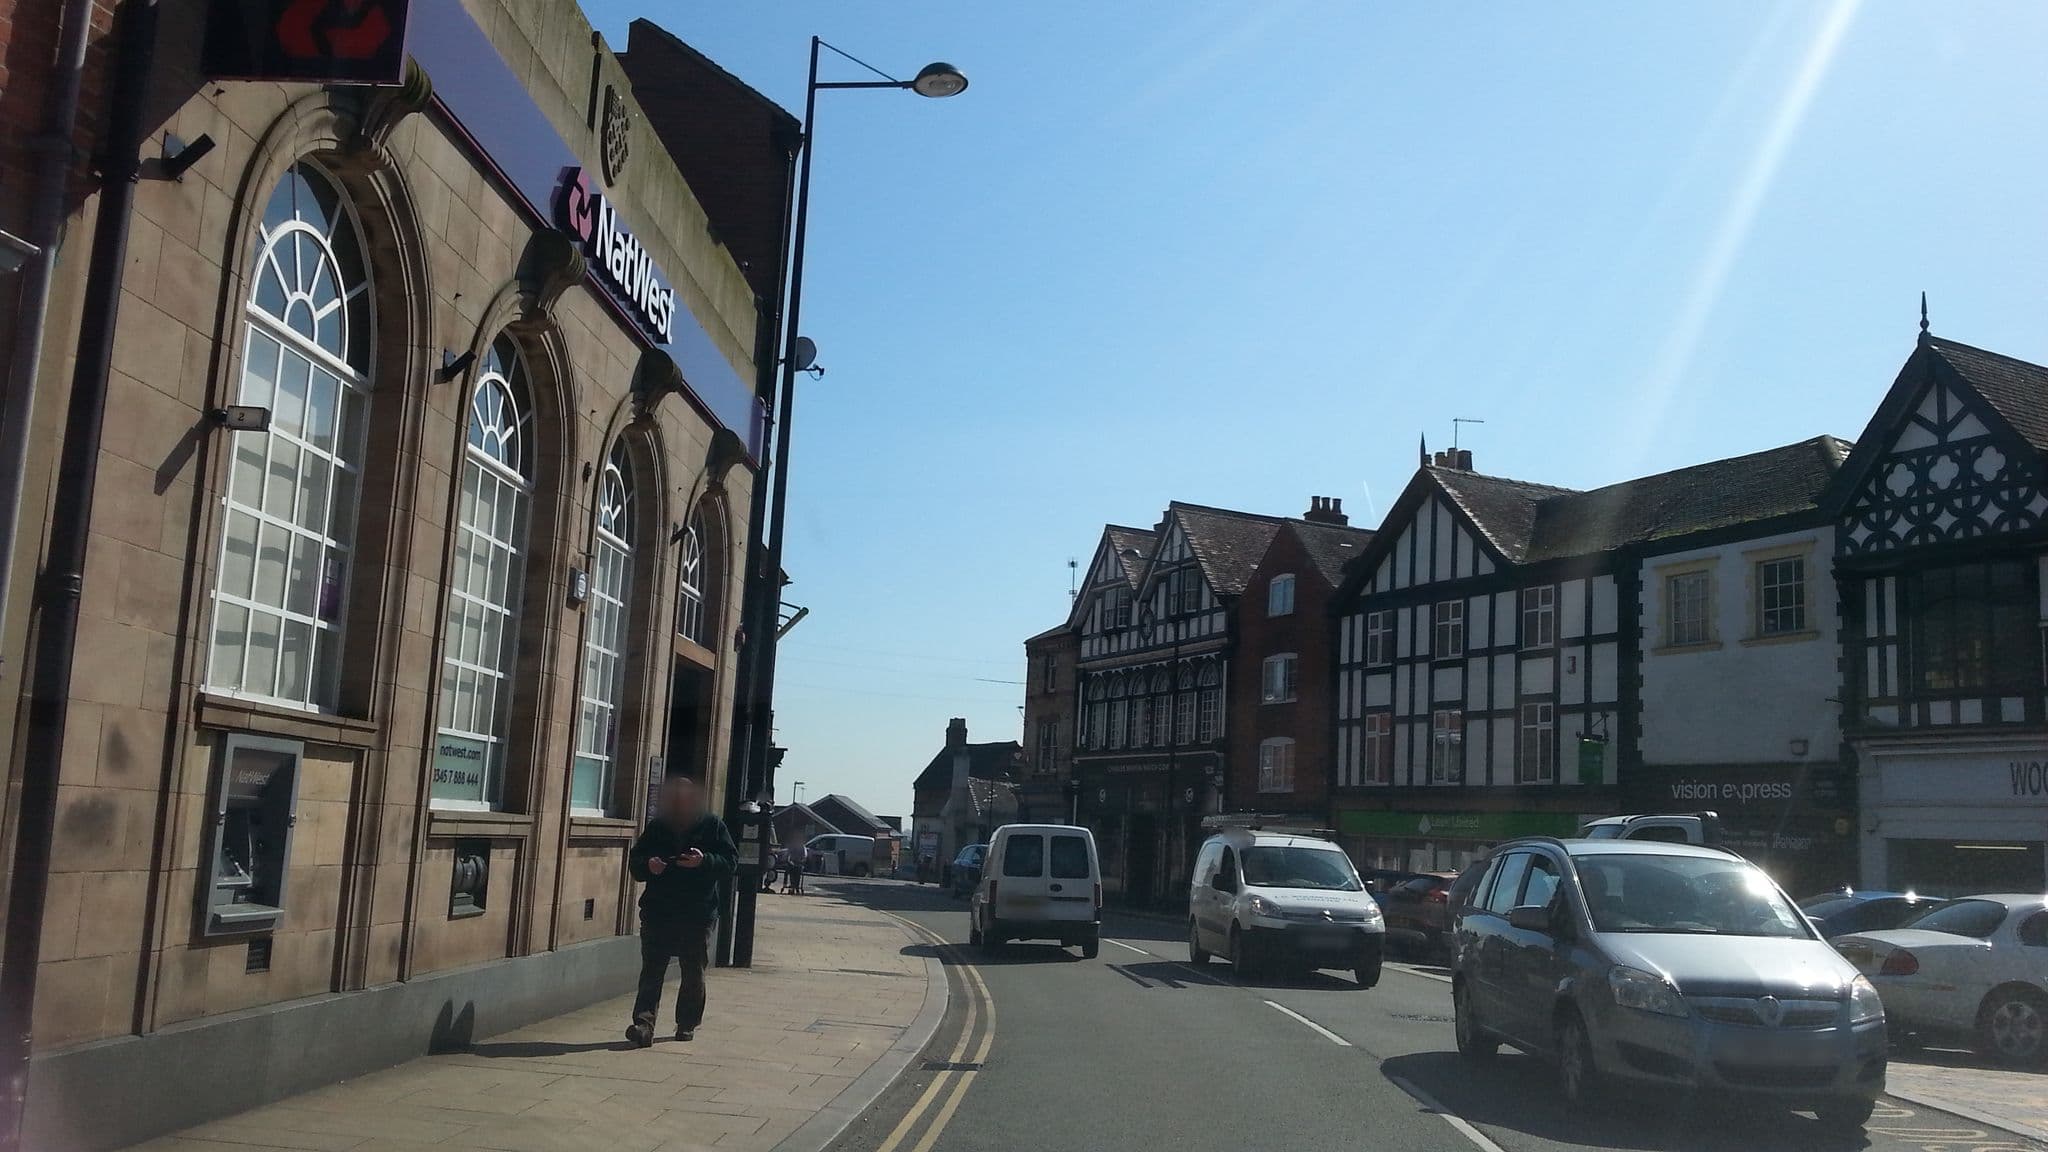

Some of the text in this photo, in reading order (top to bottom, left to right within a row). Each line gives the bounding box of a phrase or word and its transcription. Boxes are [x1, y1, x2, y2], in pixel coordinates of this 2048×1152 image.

[596, 194, 675, 345] NatWest
[440, 745, 481, 760] natwest.com
[448, 770, 453, 783] 7
[467, 772, 479, 787] 444
[1672, 780, 1717, 799] vision
[1722, 783, 1792, 803] express
